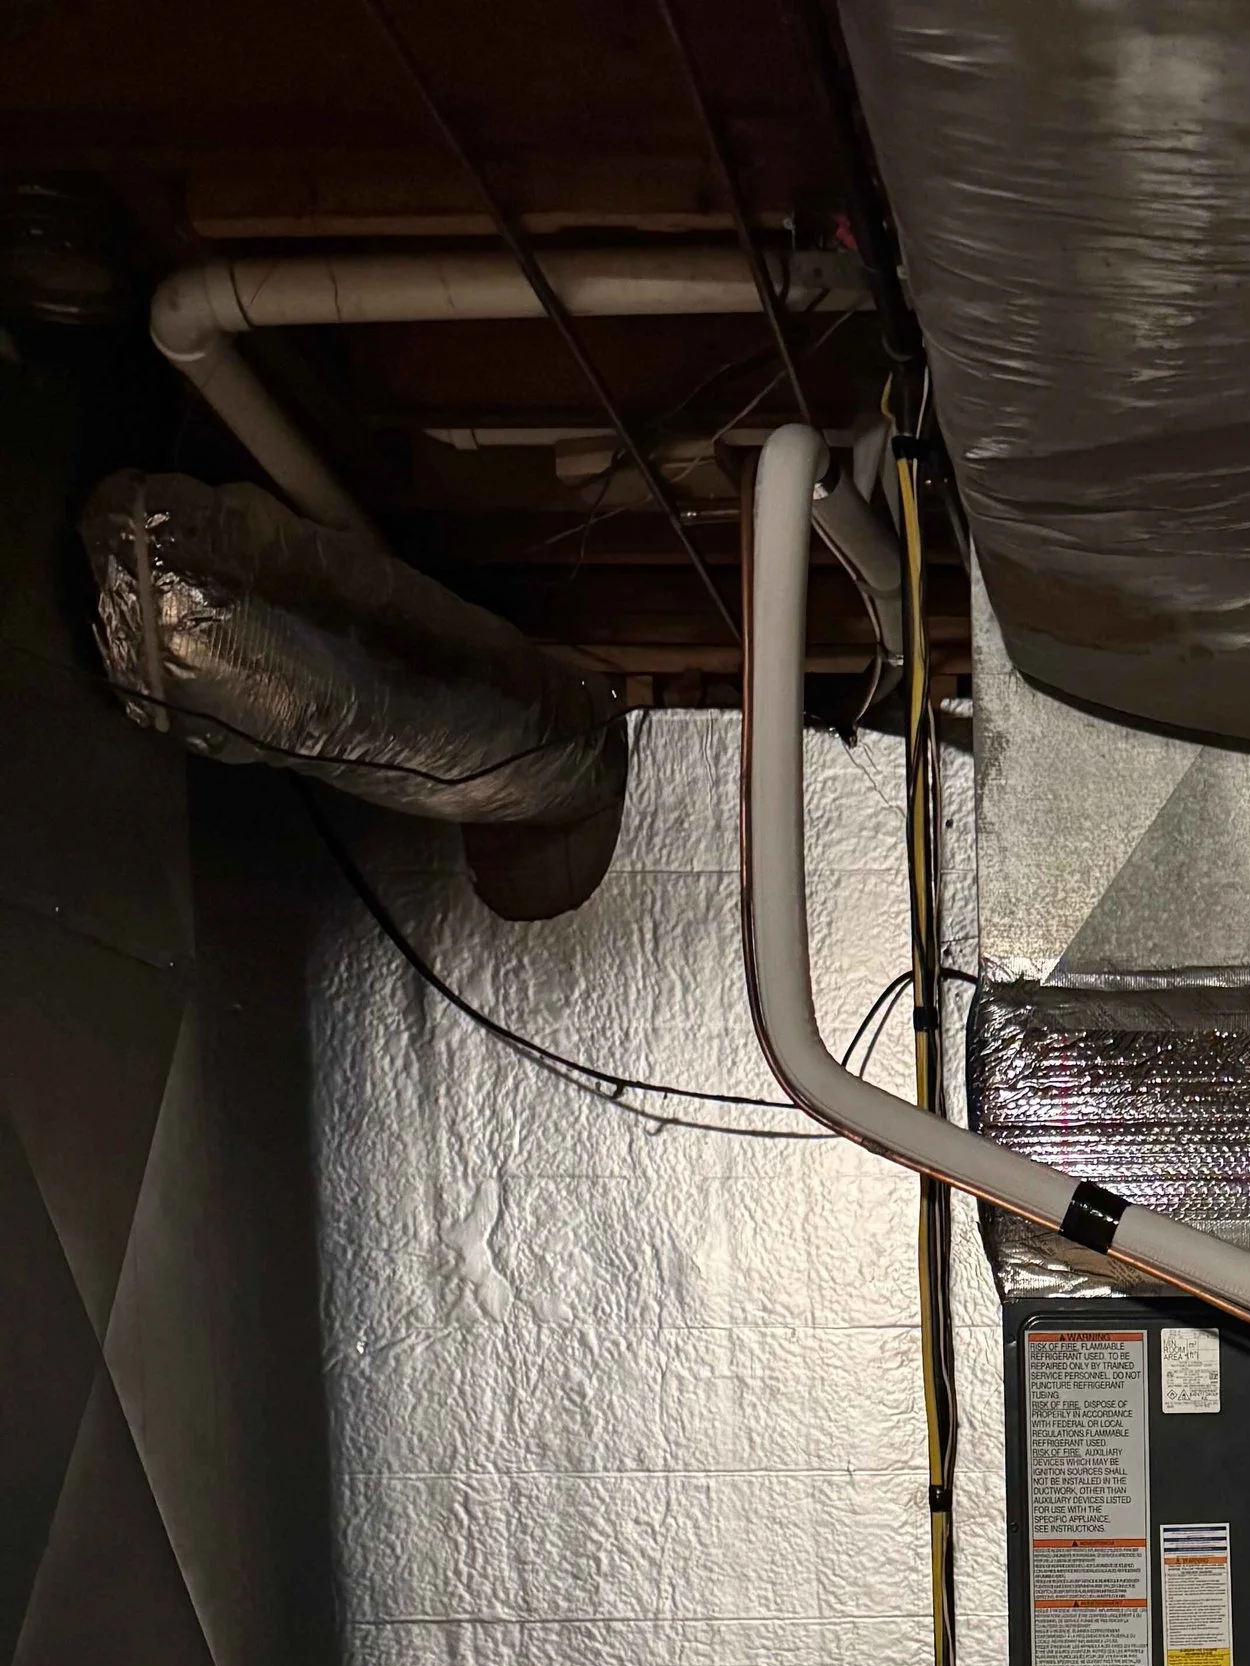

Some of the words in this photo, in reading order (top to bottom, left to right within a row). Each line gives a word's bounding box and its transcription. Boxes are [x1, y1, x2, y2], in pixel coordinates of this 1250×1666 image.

[1068, 1333, 1111, 1341] WARNING
[1030, 1343, 1046, 1351] RISK
[1048, 1343, 1059, 1351] OF
[1081, 1343, 1125, 1351] FLAMMABLE
[1030, 1352, 1082, 1360] REFRIGERANT
[1108, 1352, 1118, 1360] TO
[1120, 1352, 1130, 1360] BE
[1030, 1362, 1067, 1370] REPAIRED
[1069, 1362, 1089, 1370] ONLY
[1091, 1362, 1101, 1370] BY
[1103, 1362, 1135, 1370] TRAINED
[1031, 1372, 1064, 1380] SERVICE
[1113, 1372, 1124, 1380] DO
[1125, 1372, 1141, 1380] NOT
[1031, 1381, 1071, 1389] PUNCTURE
[1073, 1381, 1125, 1389] REFRIGERANT
[1032, 1401, 1048, 1409] RISK
[1050, 1401, 1060, 1409] OF
[1084, 1401, 1116, 1409] DISPOSE
[1118, 1401, 1128, 1409] OF
[1032, 1410, 1071, 1418] PROPERLY
[1073, 1410, 1080, 1418] IN
[1082, 1410, 1133, 1418] ACCORDANCE
[1032, 1420, 1051, 1428] WITH
[1052, 1420, 1085, 1428] FEDERAL
[1087, 1420, 1099, 1428] OR
[1100, 1420, 1123, 1428] LOCAL
[1086, 1429, 1129, 1437] FLAMMABLE
[1033, 1439, 1083, 1447] REFRIGERANT
[1033, 1449, 1049, 1457] RISK
[1051, 1449, 1060, 1457] OF
[1085, 1449, 1123, 1457] AUXILIARY
[1033, 1458, 1064, 1466] DEVICES
[1067, 1458, 1091, 1466] WHICH
[1092, 1458, 1108, 1466] MAY
[1110, 1458, 1119, 1466] BE
[1033, 1468, 1065, 1476] IGNITION
[1067, 1468, 1103, 1476] SOURCES
[1104, 1468, 1127, 1476] SHALL
[1033, 1477, 1048, 1485] NOT
[1050, 1477, 1060, 1485] BE
[1062, 1477, 1101, 1485] INSTALLED
[1103, 1477, 1110, 1485] IN
[1113, 1477, 1127, 1485] THE
[1080, 1487, 1105, 1495] OTHER
[1107, 1487, 1127, 1495] THAN
[1034, 1496, 1071, 1504] AUXILIARY
[1073, 1496, 1104, 1504] DEVICES
[1106, 1496, 1131, 1504] LISTED
[1034, 1515, 1067, 1523] SPECIFIC
[1034, 1525, 1049, 1533] SEE
